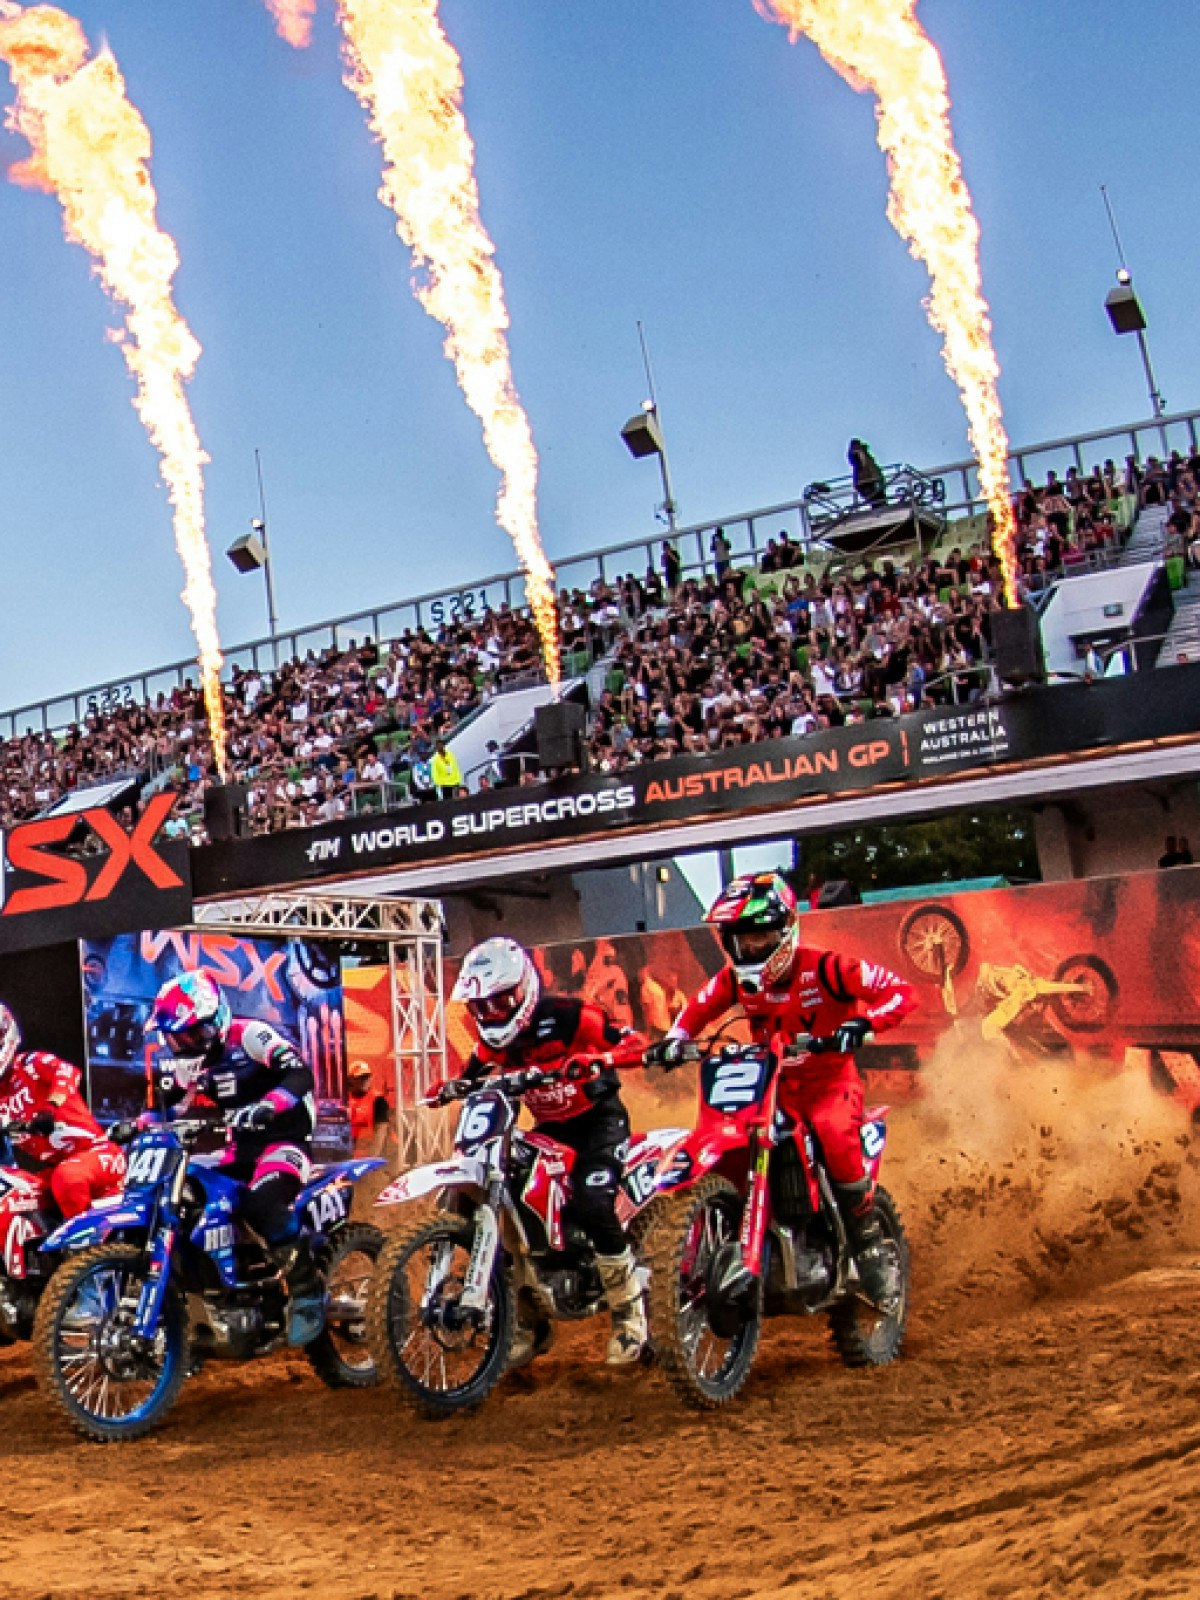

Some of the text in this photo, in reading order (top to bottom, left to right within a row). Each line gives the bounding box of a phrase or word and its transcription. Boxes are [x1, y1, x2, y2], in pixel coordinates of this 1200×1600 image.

[920, 725, 1007, 751] AUSTRALIA
[922, 706, 1000, 734] WESTERN
[351, 819, 445, 854] WORLD
[451, 784, 636, 838] SUPERCROSS
[644, 748, 840, 805] AUSTRALIAN
[847, 739, 891, 768] GP
[709, 1062, 763, 1104] 2
[457, 1100, 495, 1141] 16
[124, 1148, 168, 1184] 141
[307, 1188, 346, 1233] 141
